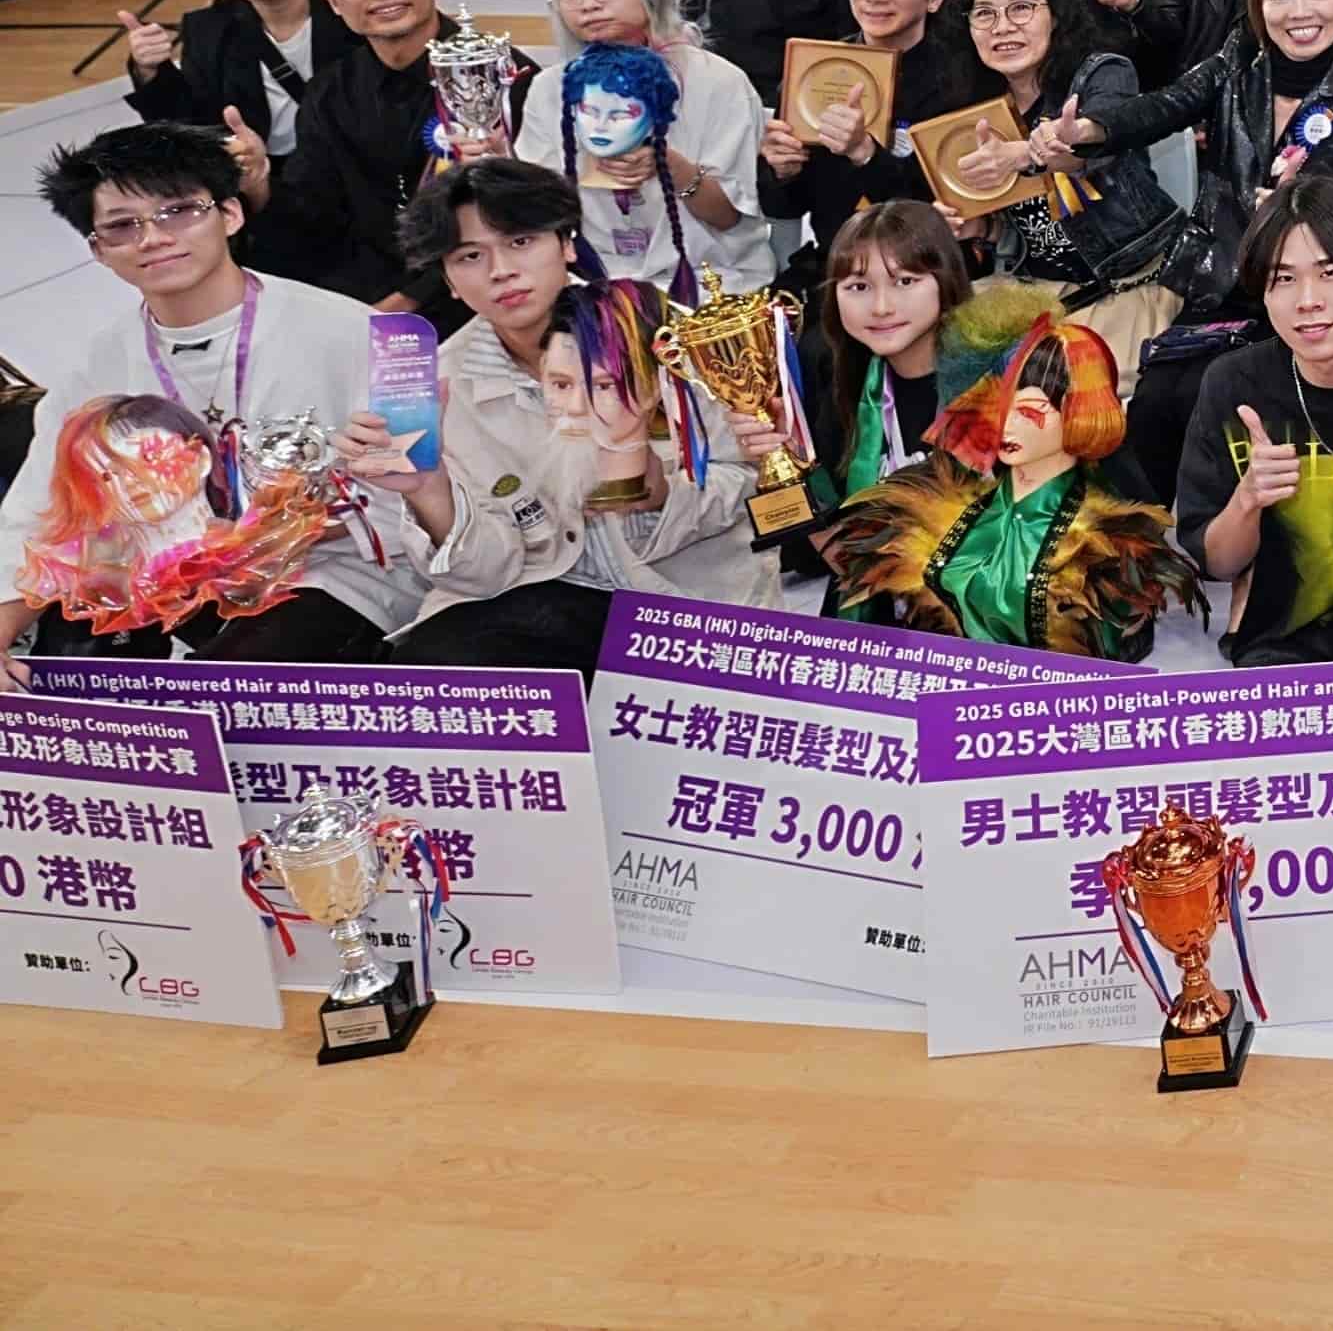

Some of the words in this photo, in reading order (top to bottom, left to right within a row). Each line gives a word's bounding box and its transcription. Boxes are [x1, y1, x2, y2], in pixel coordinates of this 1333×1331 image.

[635, 606, 670, 626] 2025
[672, 611, 701, 631] GBA
[704, 616, 737, 637] (HK)
[740, 621, 859, 656] Digital-Powered
[861, 638, 893, 660] Hair
[896, 644, 923, 663] and
[927, 648, 973, 672] Image
[976, 654, 1028, 680] Design
[48, 672, 87, 691] (HK)
[90, 674, 232, 695] Digital-Powered
[235, 678, 271, 694] Hair
[276, 679, 310, 696] and
[315, 681, 370, 700] Image
[374, 682, 434, 702] Design
[438, 683, 552, 704] Competition
[956, 703, 1002, 722] 2025
[1008, 701, 1049, 719] GBA
[1054, 697, 1098, 718] (HK)
[1104, 683, 1262, 714] Digital-Powered
[1267, 681, 1309, 700] Hair
[27, 714, 81, 732] Design
[86, 721, 189, 741] Competition
[610, 693, 919, 786] 女士教習頭髮型及
[667, 773, 766, 842] 冠軍
[770, 795, 900, 863] 3,000
[37, 855, 137, 911] 港幣
[614, 849, 699, 891] AHMA
[642, 896, 694, 917] COUNCIL
[1019, 945, 1136, 983] AHMA
[1024, 994, 1061, 1008] HAIR
[1068, 987, 1137, 1004] COUNCIL
